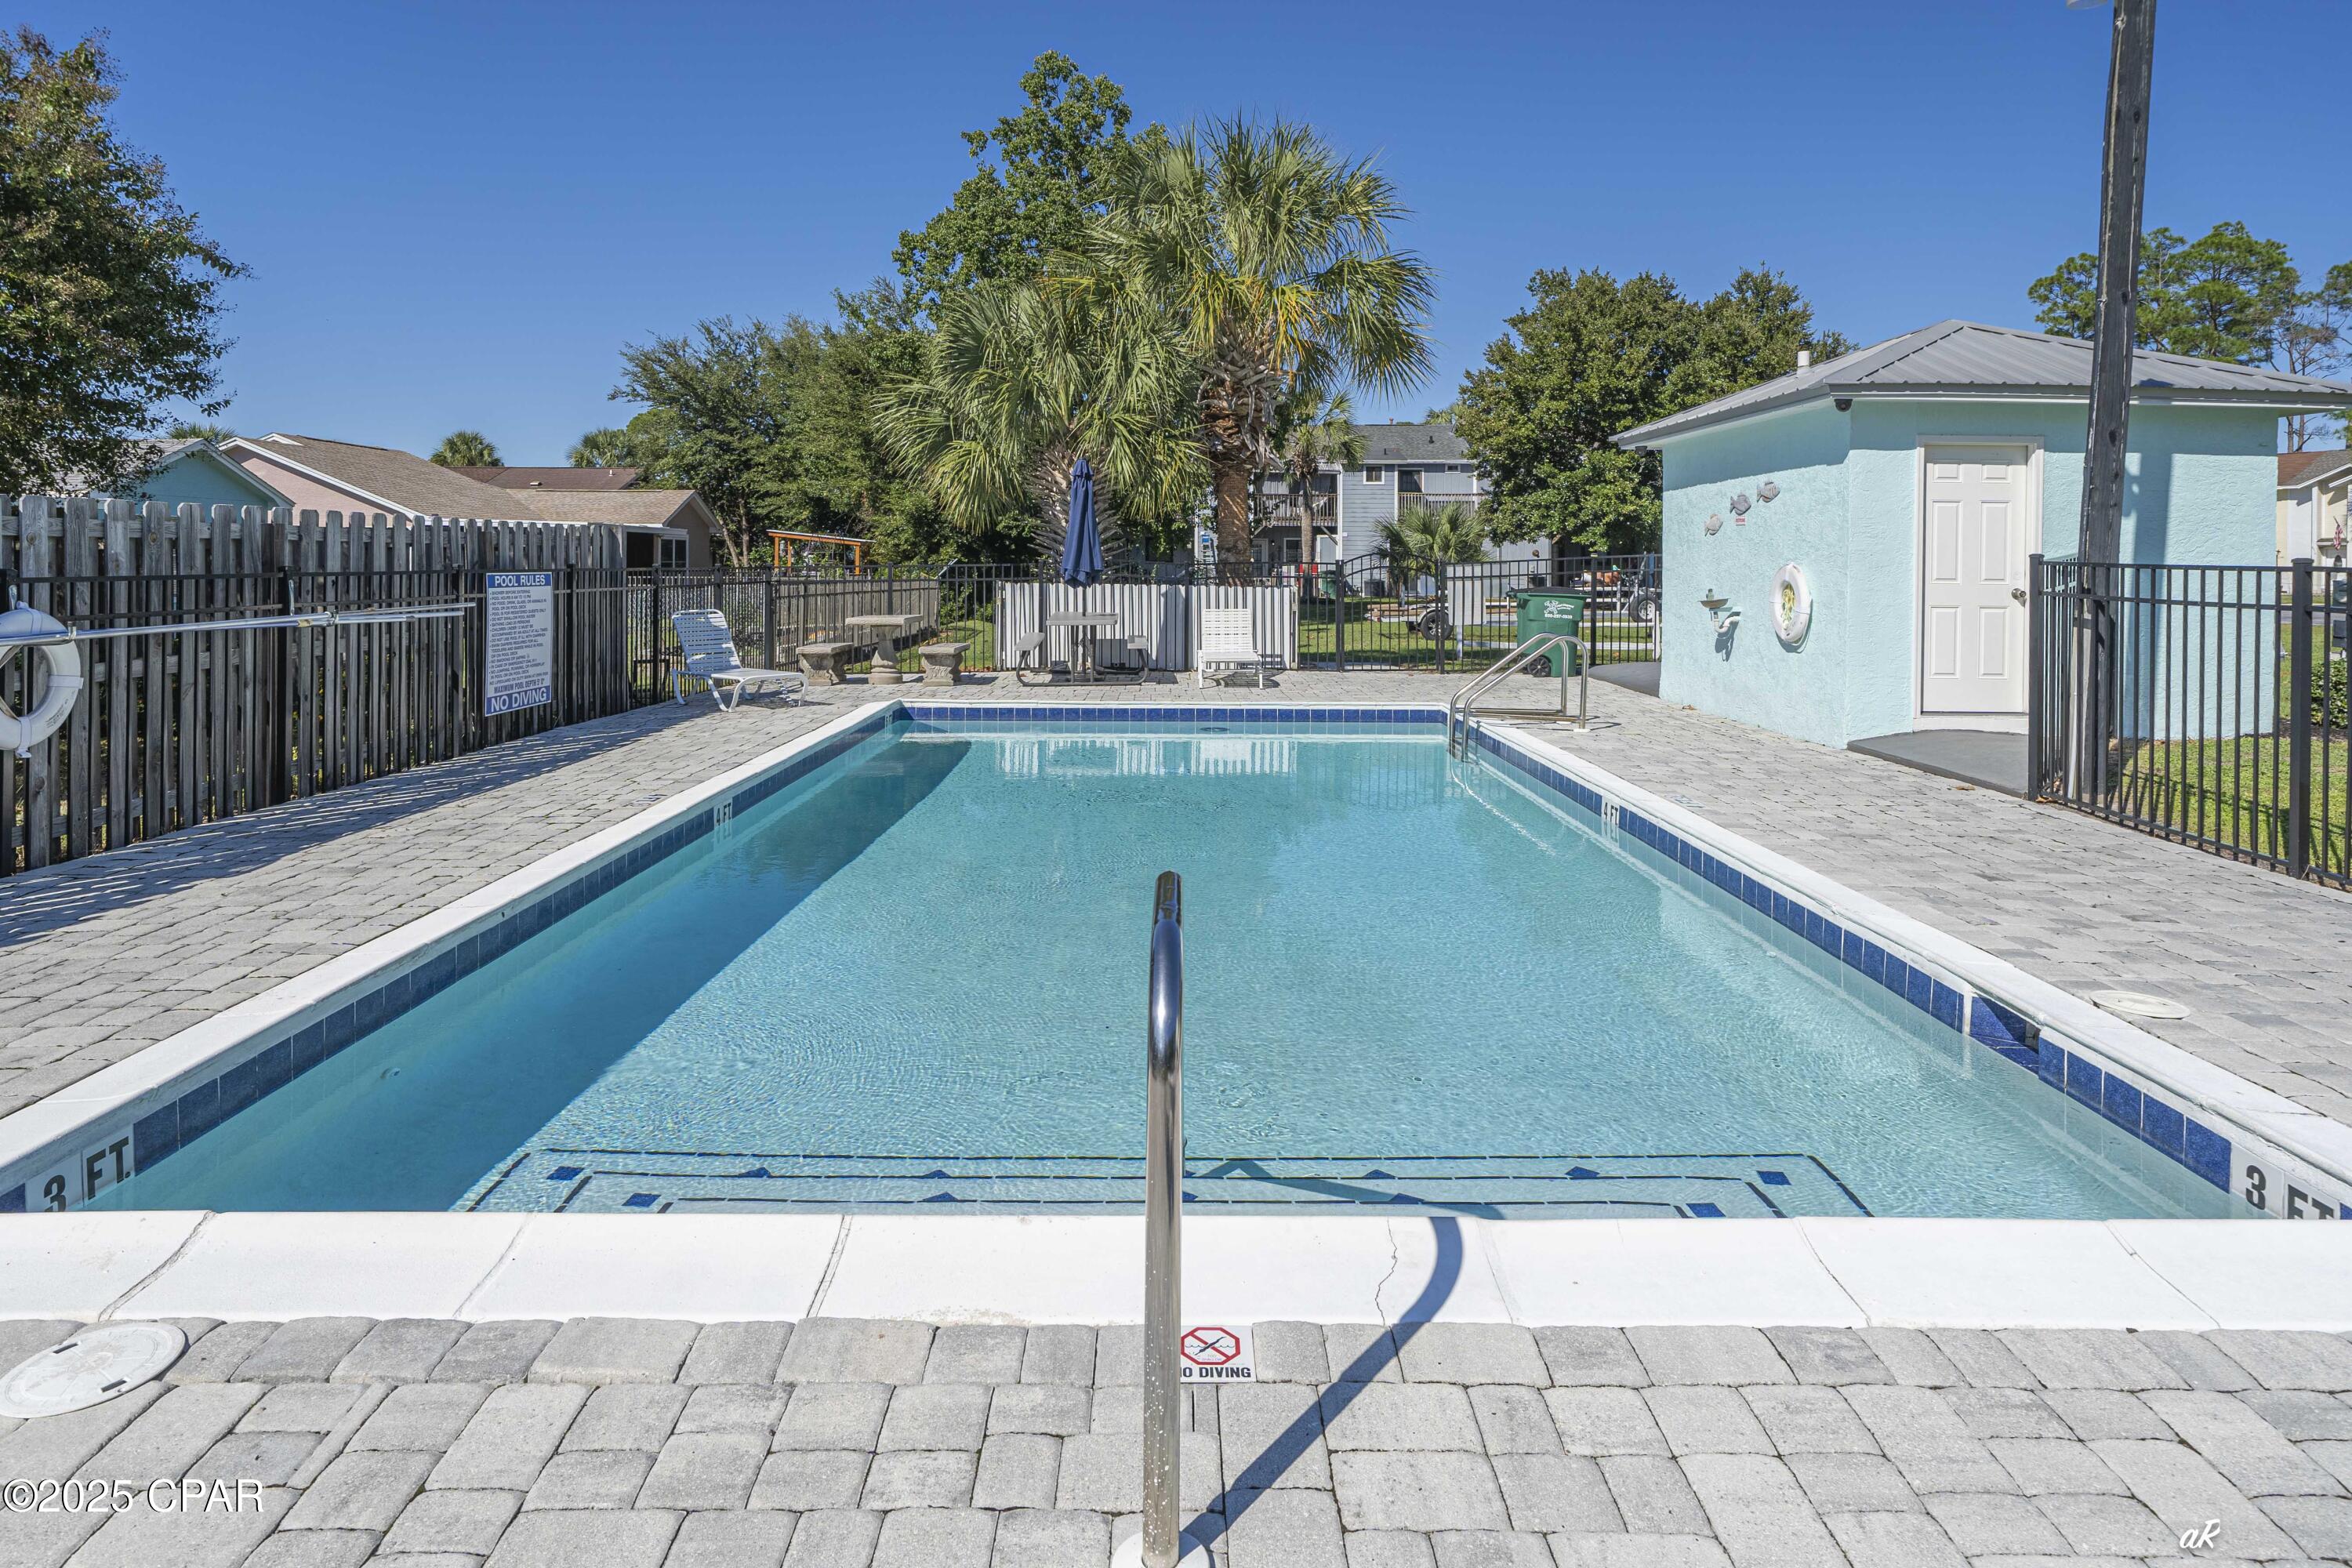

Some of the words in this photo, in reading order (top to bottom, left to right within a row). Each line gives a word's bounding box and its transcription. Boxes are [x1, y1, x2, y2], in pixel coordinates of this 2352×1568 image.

[495, 576, 518, 587] POOL
[520, 575, 545, 585] RULES
[494, 683, 514, 694] MAXIMUM
[515, 681, 524, 690] POOL
[525, 679, 536, 688] DEPTH
[491, 695, 508, 713] NO
[512, 687, 546, 708] DIVING
[717, 808, 720, 826] 4
[1604, 802, 1607, 820] 4
[44, 1174, 66, 1212] 3
[86, 1136, 131, 1200] FT.
[2246, 1165, 2266, 1210] 3
[1181, 1367, 1192, 1377] O
[1199, 1367, 1251, 1378] DIVING
